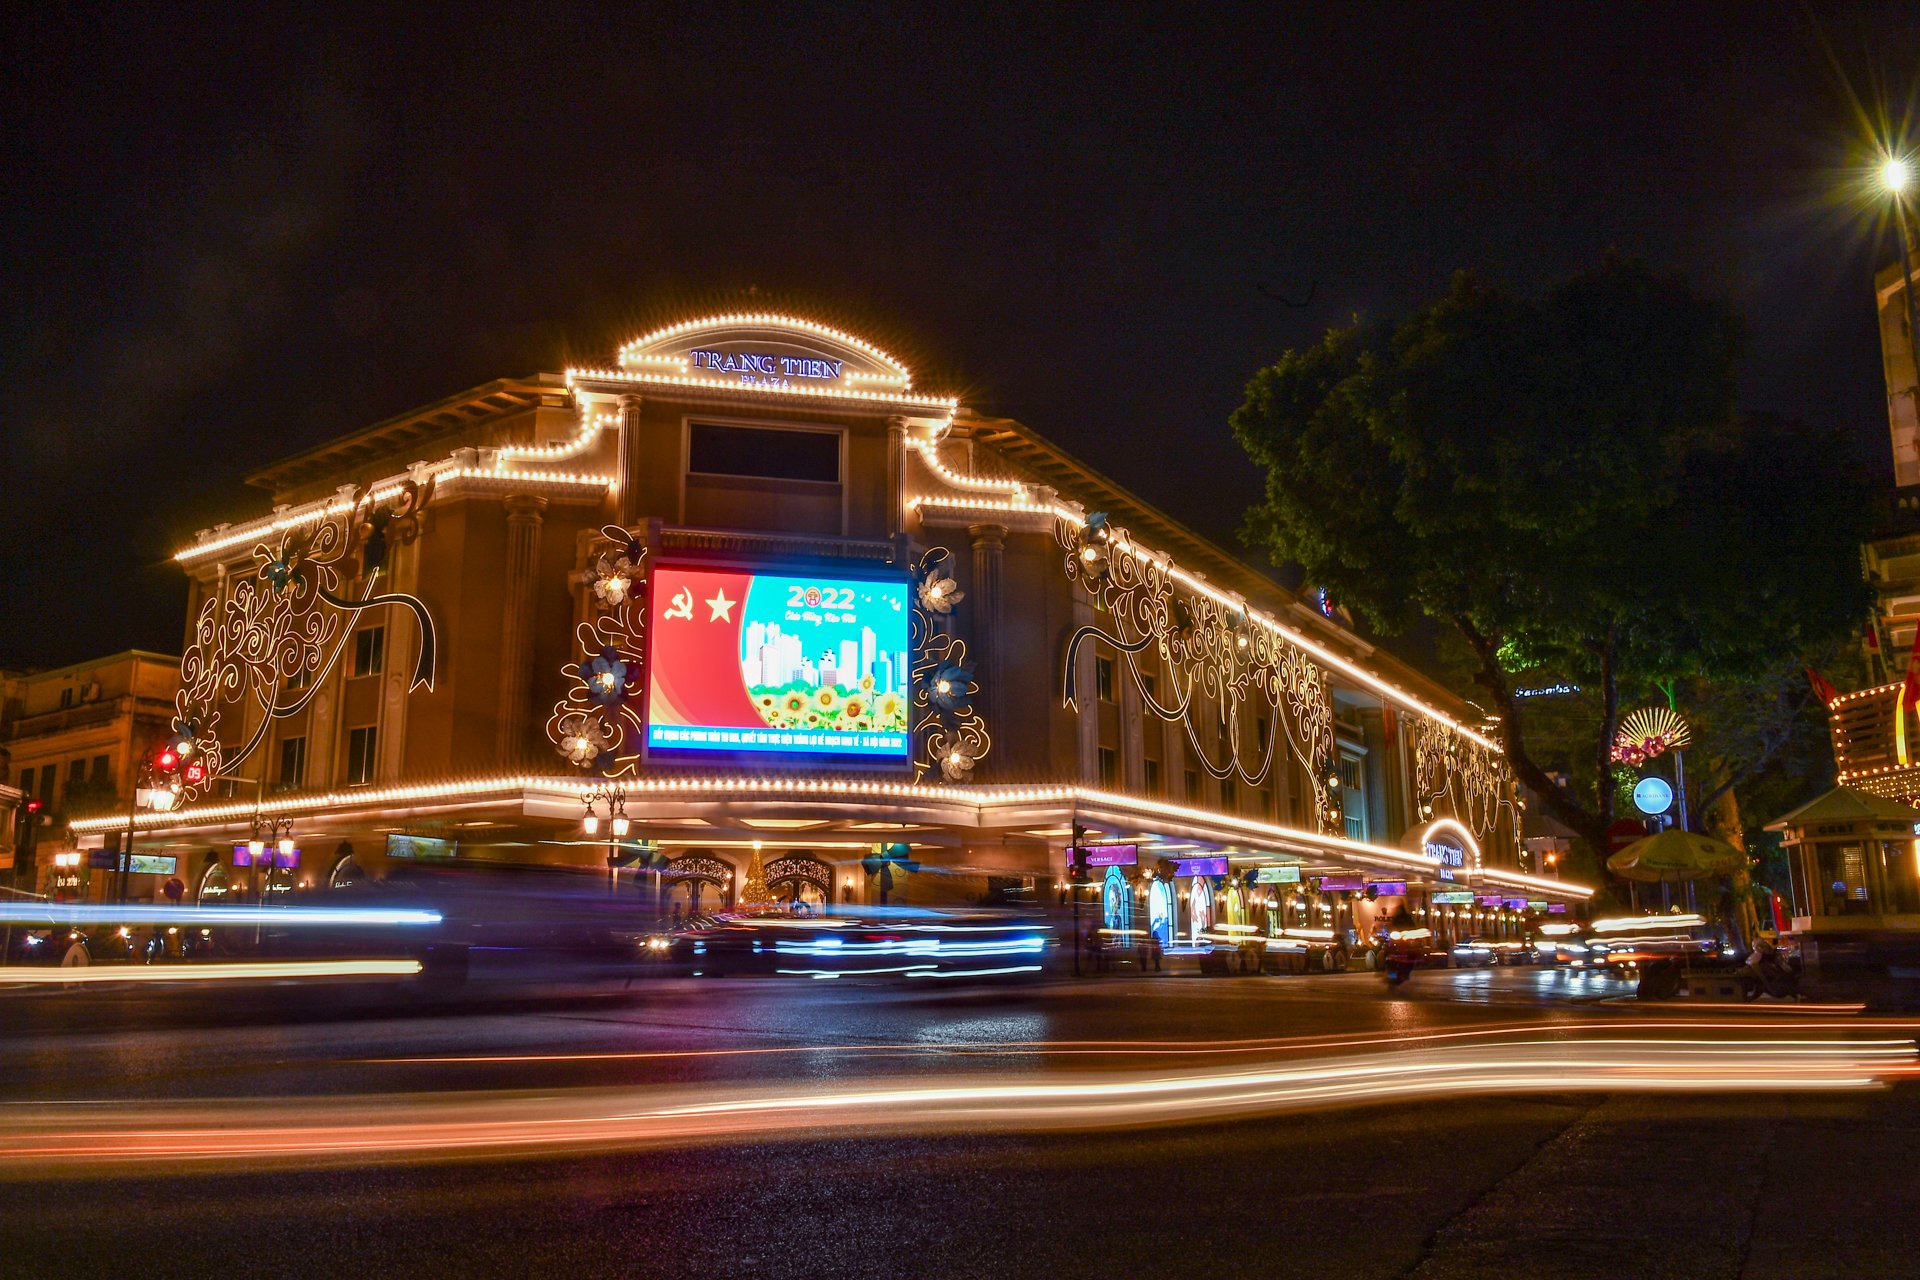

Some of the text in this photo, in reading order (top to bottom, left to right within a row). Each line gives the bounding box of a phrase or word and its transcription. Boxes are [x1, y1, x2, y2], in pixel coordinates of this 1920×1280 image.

[690, 350, 843, 379] TRANG TIEN
[741, 374, 790, 388] PLAZA
[786, 585, 856, 610] 2022
